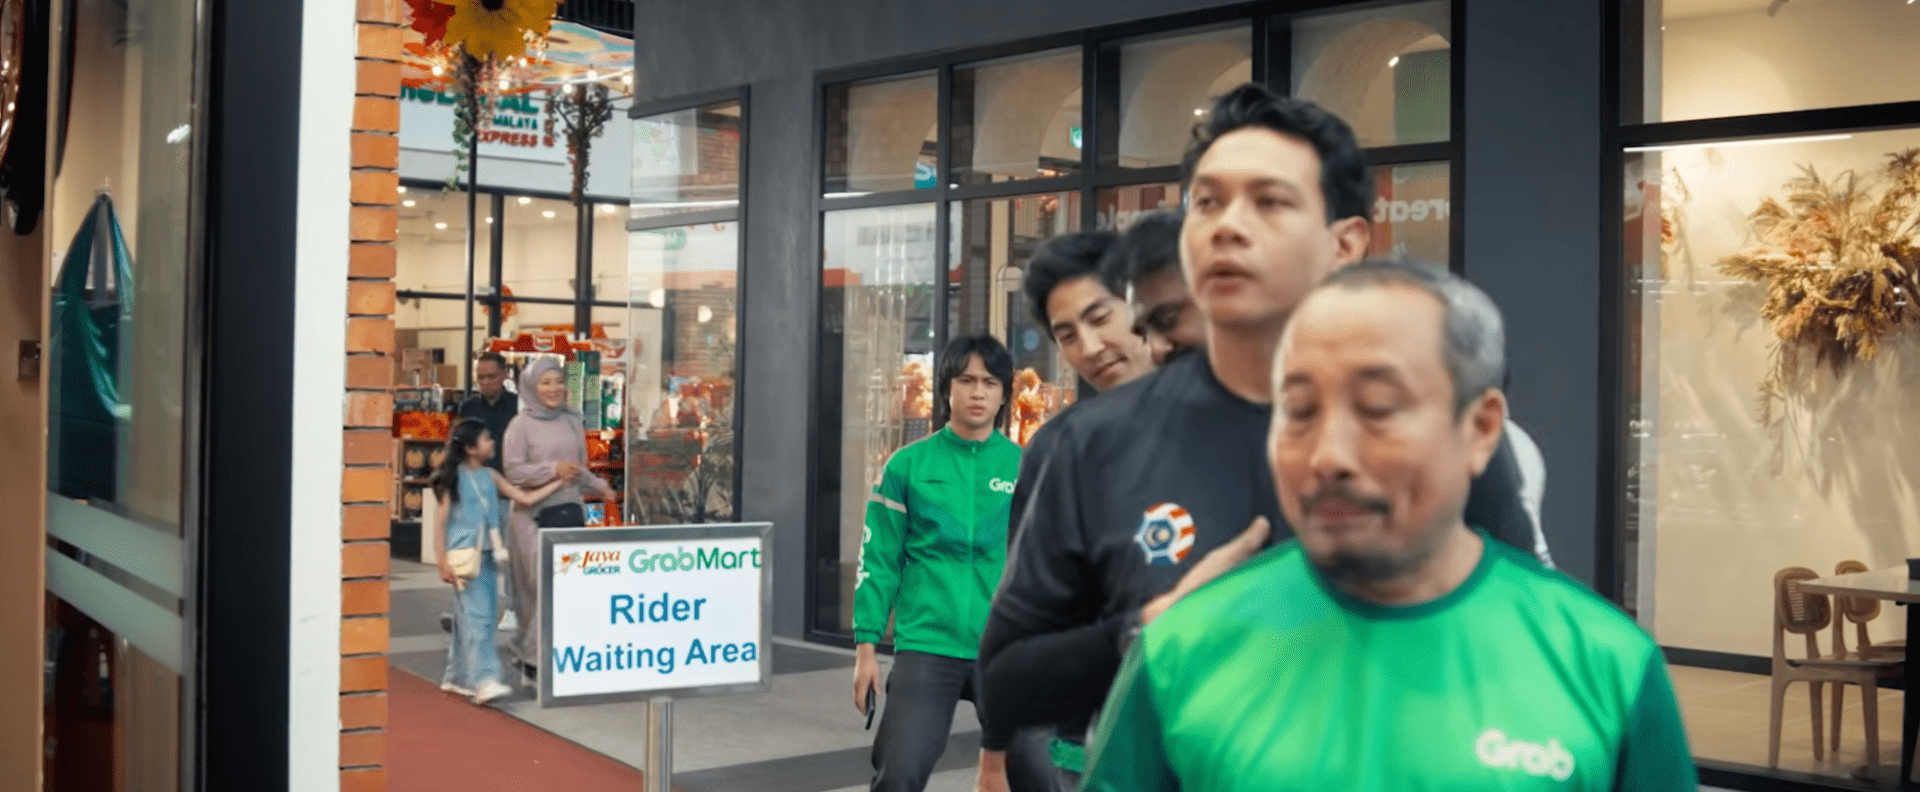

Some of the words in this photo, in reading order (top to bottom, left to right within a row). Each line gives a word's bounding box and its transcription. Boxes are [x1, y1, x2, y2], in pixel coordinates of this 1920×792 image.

[989, 477, 1018, 494] Gra
[578, 550, 621, 569] Jaya
[628, 546, 762, 574] GrabMart
[610, 592, 707, 625] Rider
[552, 642, 675, 675] Waiting
[684, 638, 758, 666] Area
[1475, 728, 1576, 781] Grab
